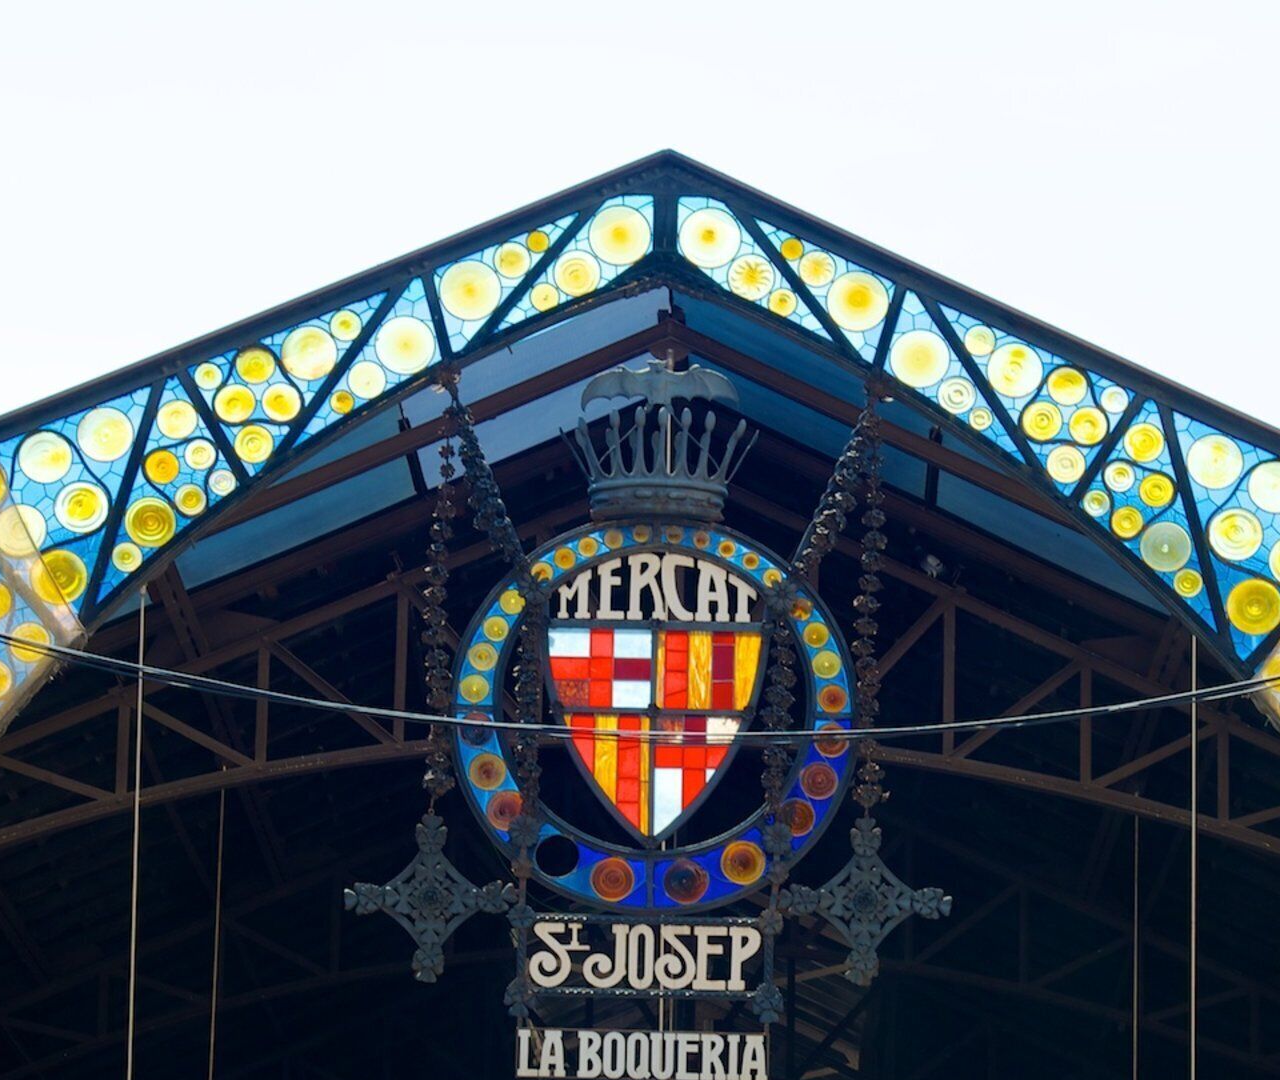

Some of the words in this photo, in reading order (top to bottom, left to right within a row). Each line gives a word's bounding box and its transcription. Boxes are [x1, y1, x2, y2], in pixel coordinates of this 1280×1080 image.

[558, 552, 757, 622] MERCAT
[583, 923, 762, 991] JOSEP
[518, 1029, 565, 1077] LA
